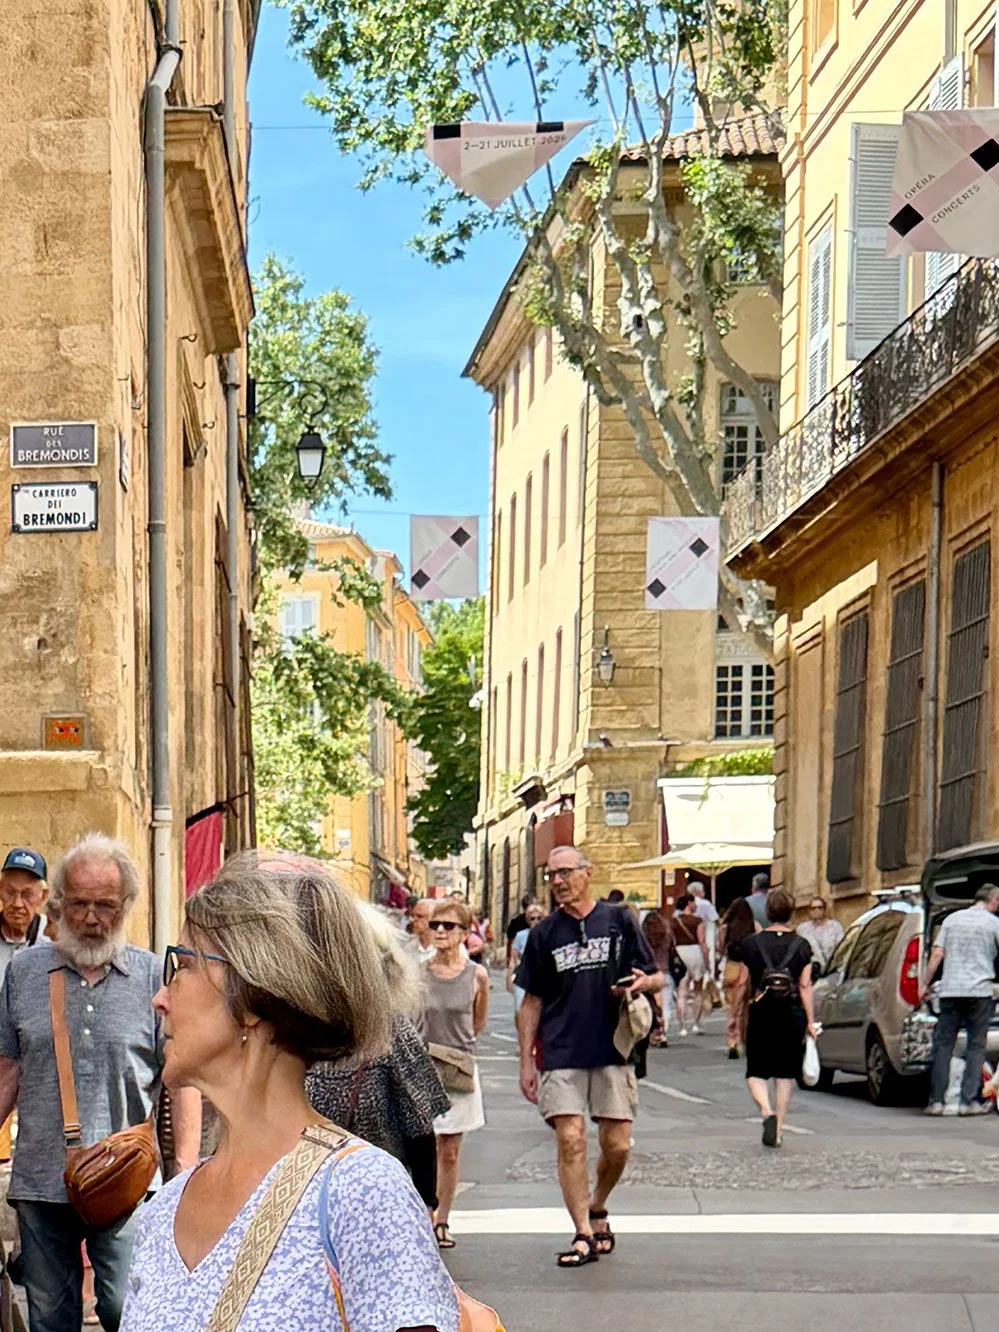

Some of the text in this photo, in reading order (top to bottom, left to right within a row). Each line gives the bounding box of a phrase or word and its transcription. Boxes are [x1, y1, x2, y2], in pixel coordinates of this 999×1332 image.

[494, 137, 536, 149] JUILLET
[931, 183, 981, 224] CONCERTS
[43, 427, 64, 436] RUE
[46, 440, 62, 448] DES
[17, 448, 90, 461] BREMONDIS
[32, 488, 77, 499] CARRIERO
[47, 500, 62, 509] DEI
[23, 512, 86, 526] BREMONDI
